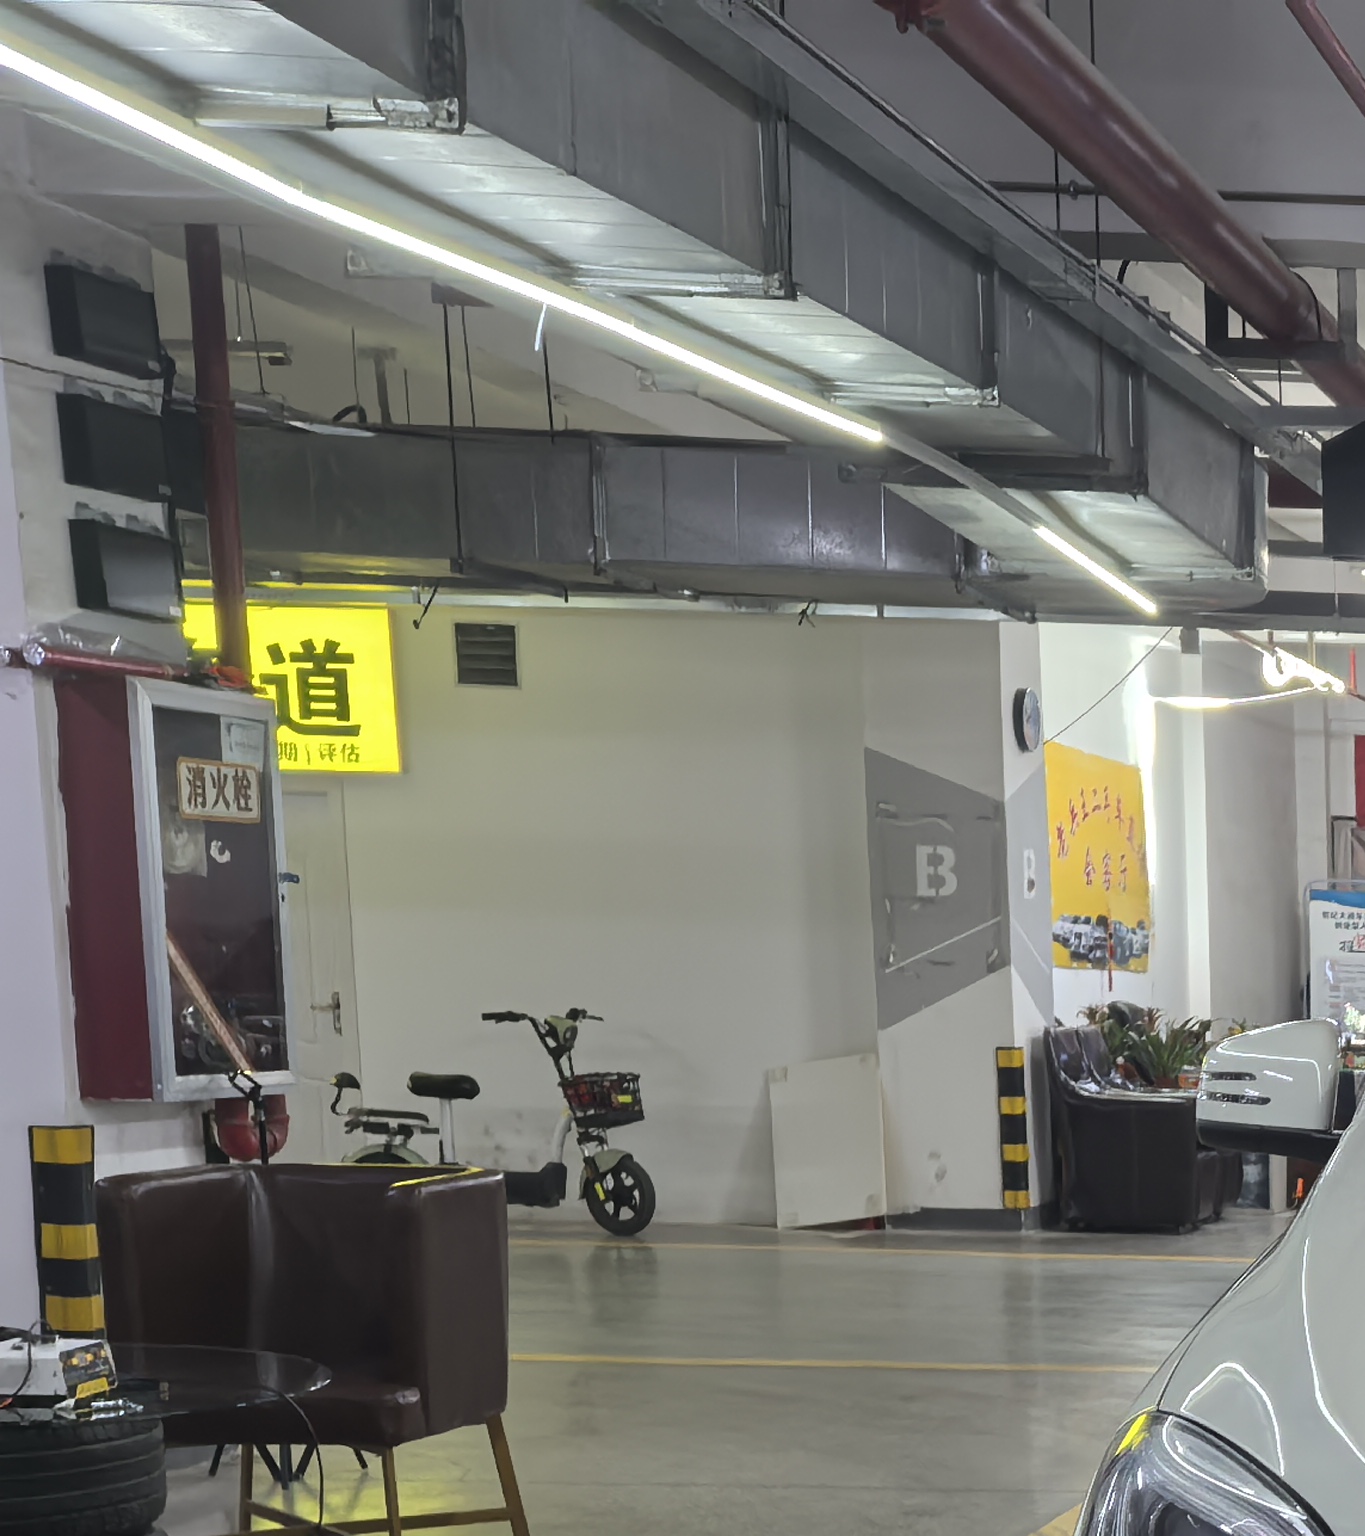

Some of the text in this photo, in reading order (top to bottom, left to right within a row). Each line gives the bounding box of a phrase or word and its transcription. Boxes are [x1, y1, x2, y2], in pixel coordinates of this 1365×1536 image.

[259, 639, 361, 737] 道
[186, 765, 253, 812] 消火栓
[916, 844, 958, 897] B
[1023, 848, 1036, 899] B
